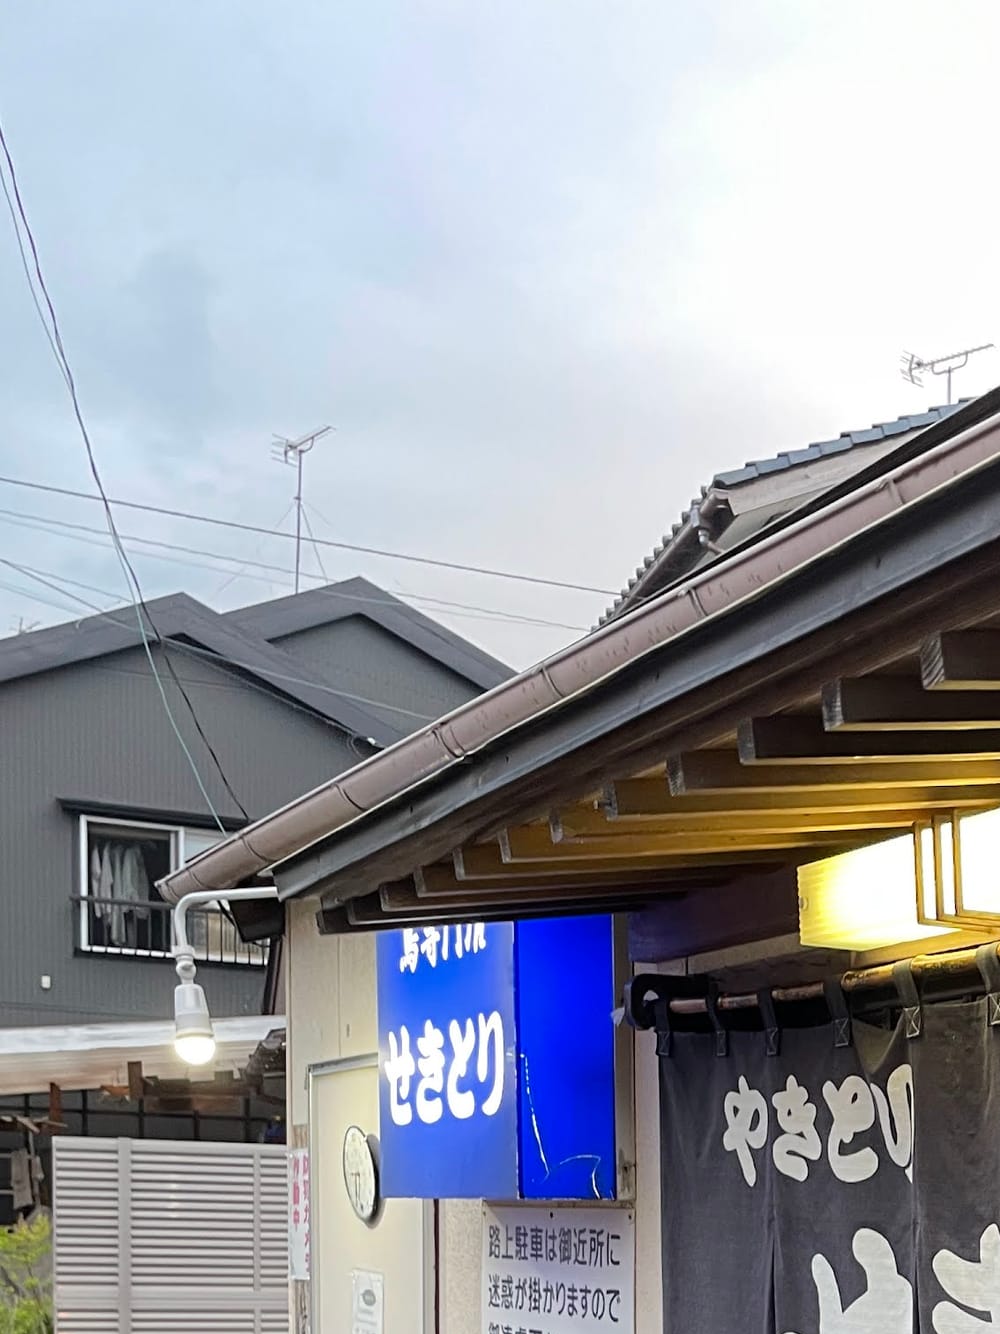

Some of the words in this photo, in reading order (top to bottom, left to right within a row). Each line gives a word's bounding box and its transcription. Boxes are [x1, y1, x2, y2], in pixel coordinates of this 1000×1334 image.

[384, 1011, 504, 1127] せきとり
[723, 1063, 914, 1187] やきとり
[488, 1224, 621, 1268] 路上駐車は御近所に
[488, 1273, 621, 1323] 迷惑が掛かりますので
